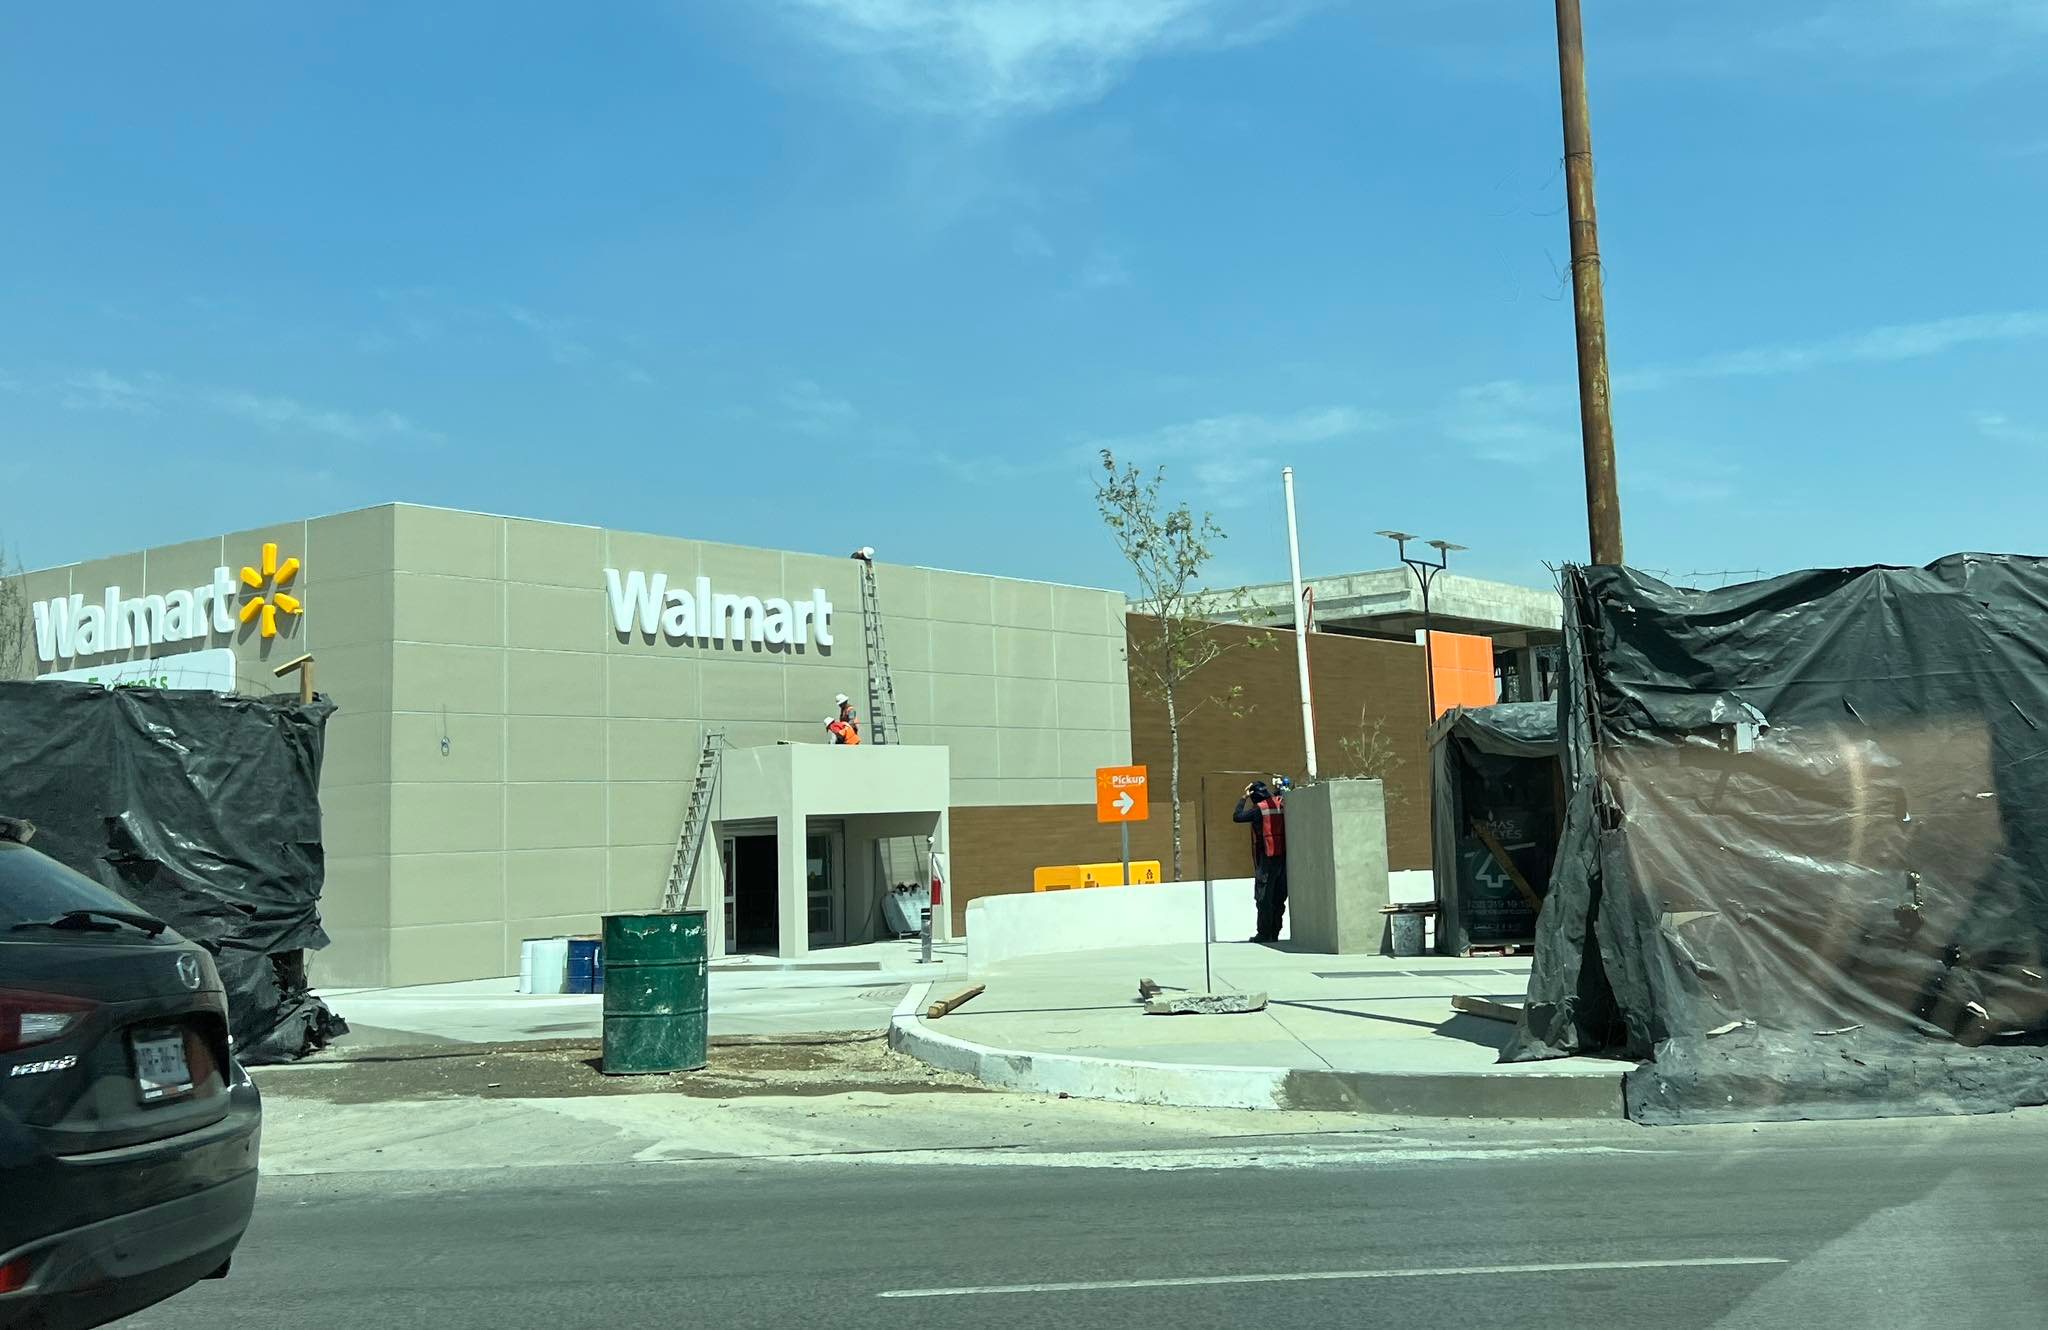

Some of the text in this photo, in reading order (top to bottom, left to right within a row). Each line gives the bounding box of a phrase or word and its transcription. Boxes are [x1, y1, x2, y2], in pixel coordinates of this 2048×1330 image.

[33, 565, 237, 662] Walmart
[603, 568, 834, 647] Walmart
[1112, 775, 1146, 785] Pickup
